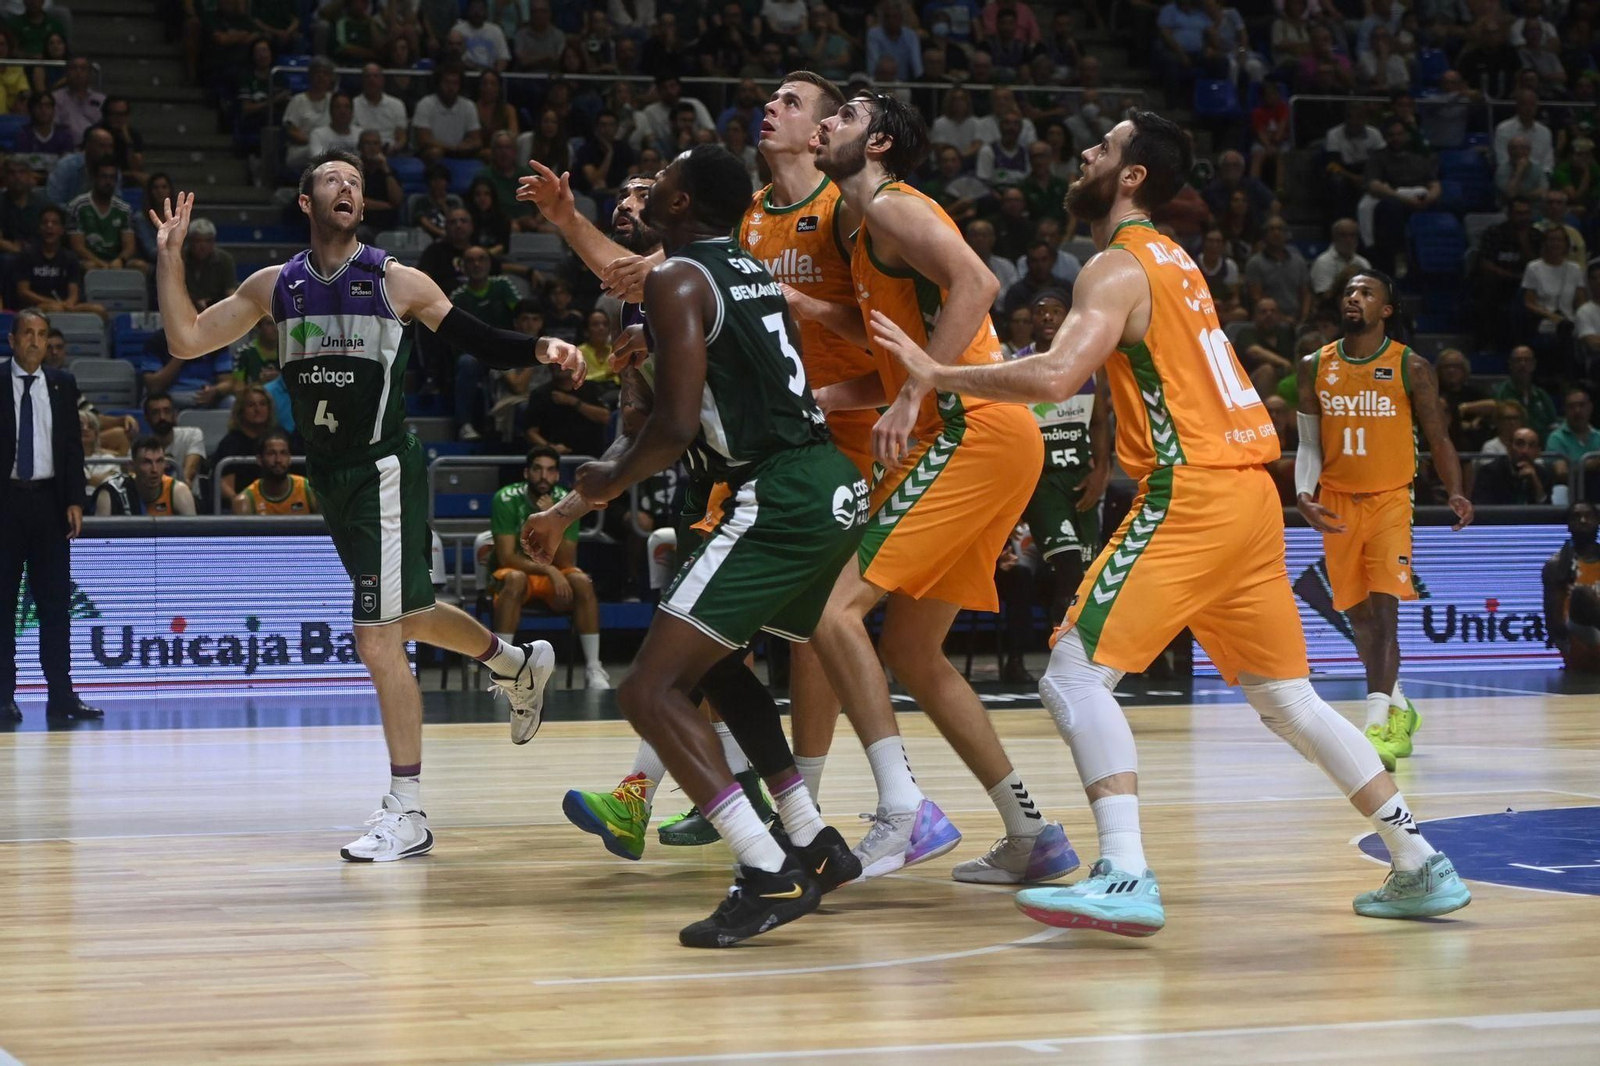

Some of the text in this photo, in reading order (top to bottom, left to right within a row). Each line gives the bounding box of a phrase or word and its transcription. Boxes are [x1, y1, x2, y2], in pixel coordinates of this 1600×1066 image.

[759, 249, 822, 277] villa.
[761, 312, 806, 397] 3
[1199, 328, 1263, 411] 10
[314, 400, 339, 433] 4
[1051, 448, 1080, 467] 55
[1343, 427, 1367, 456] 11
[1422, 598, 1550, 646] Unica
[91, 616, 290, 675] Unicaja
